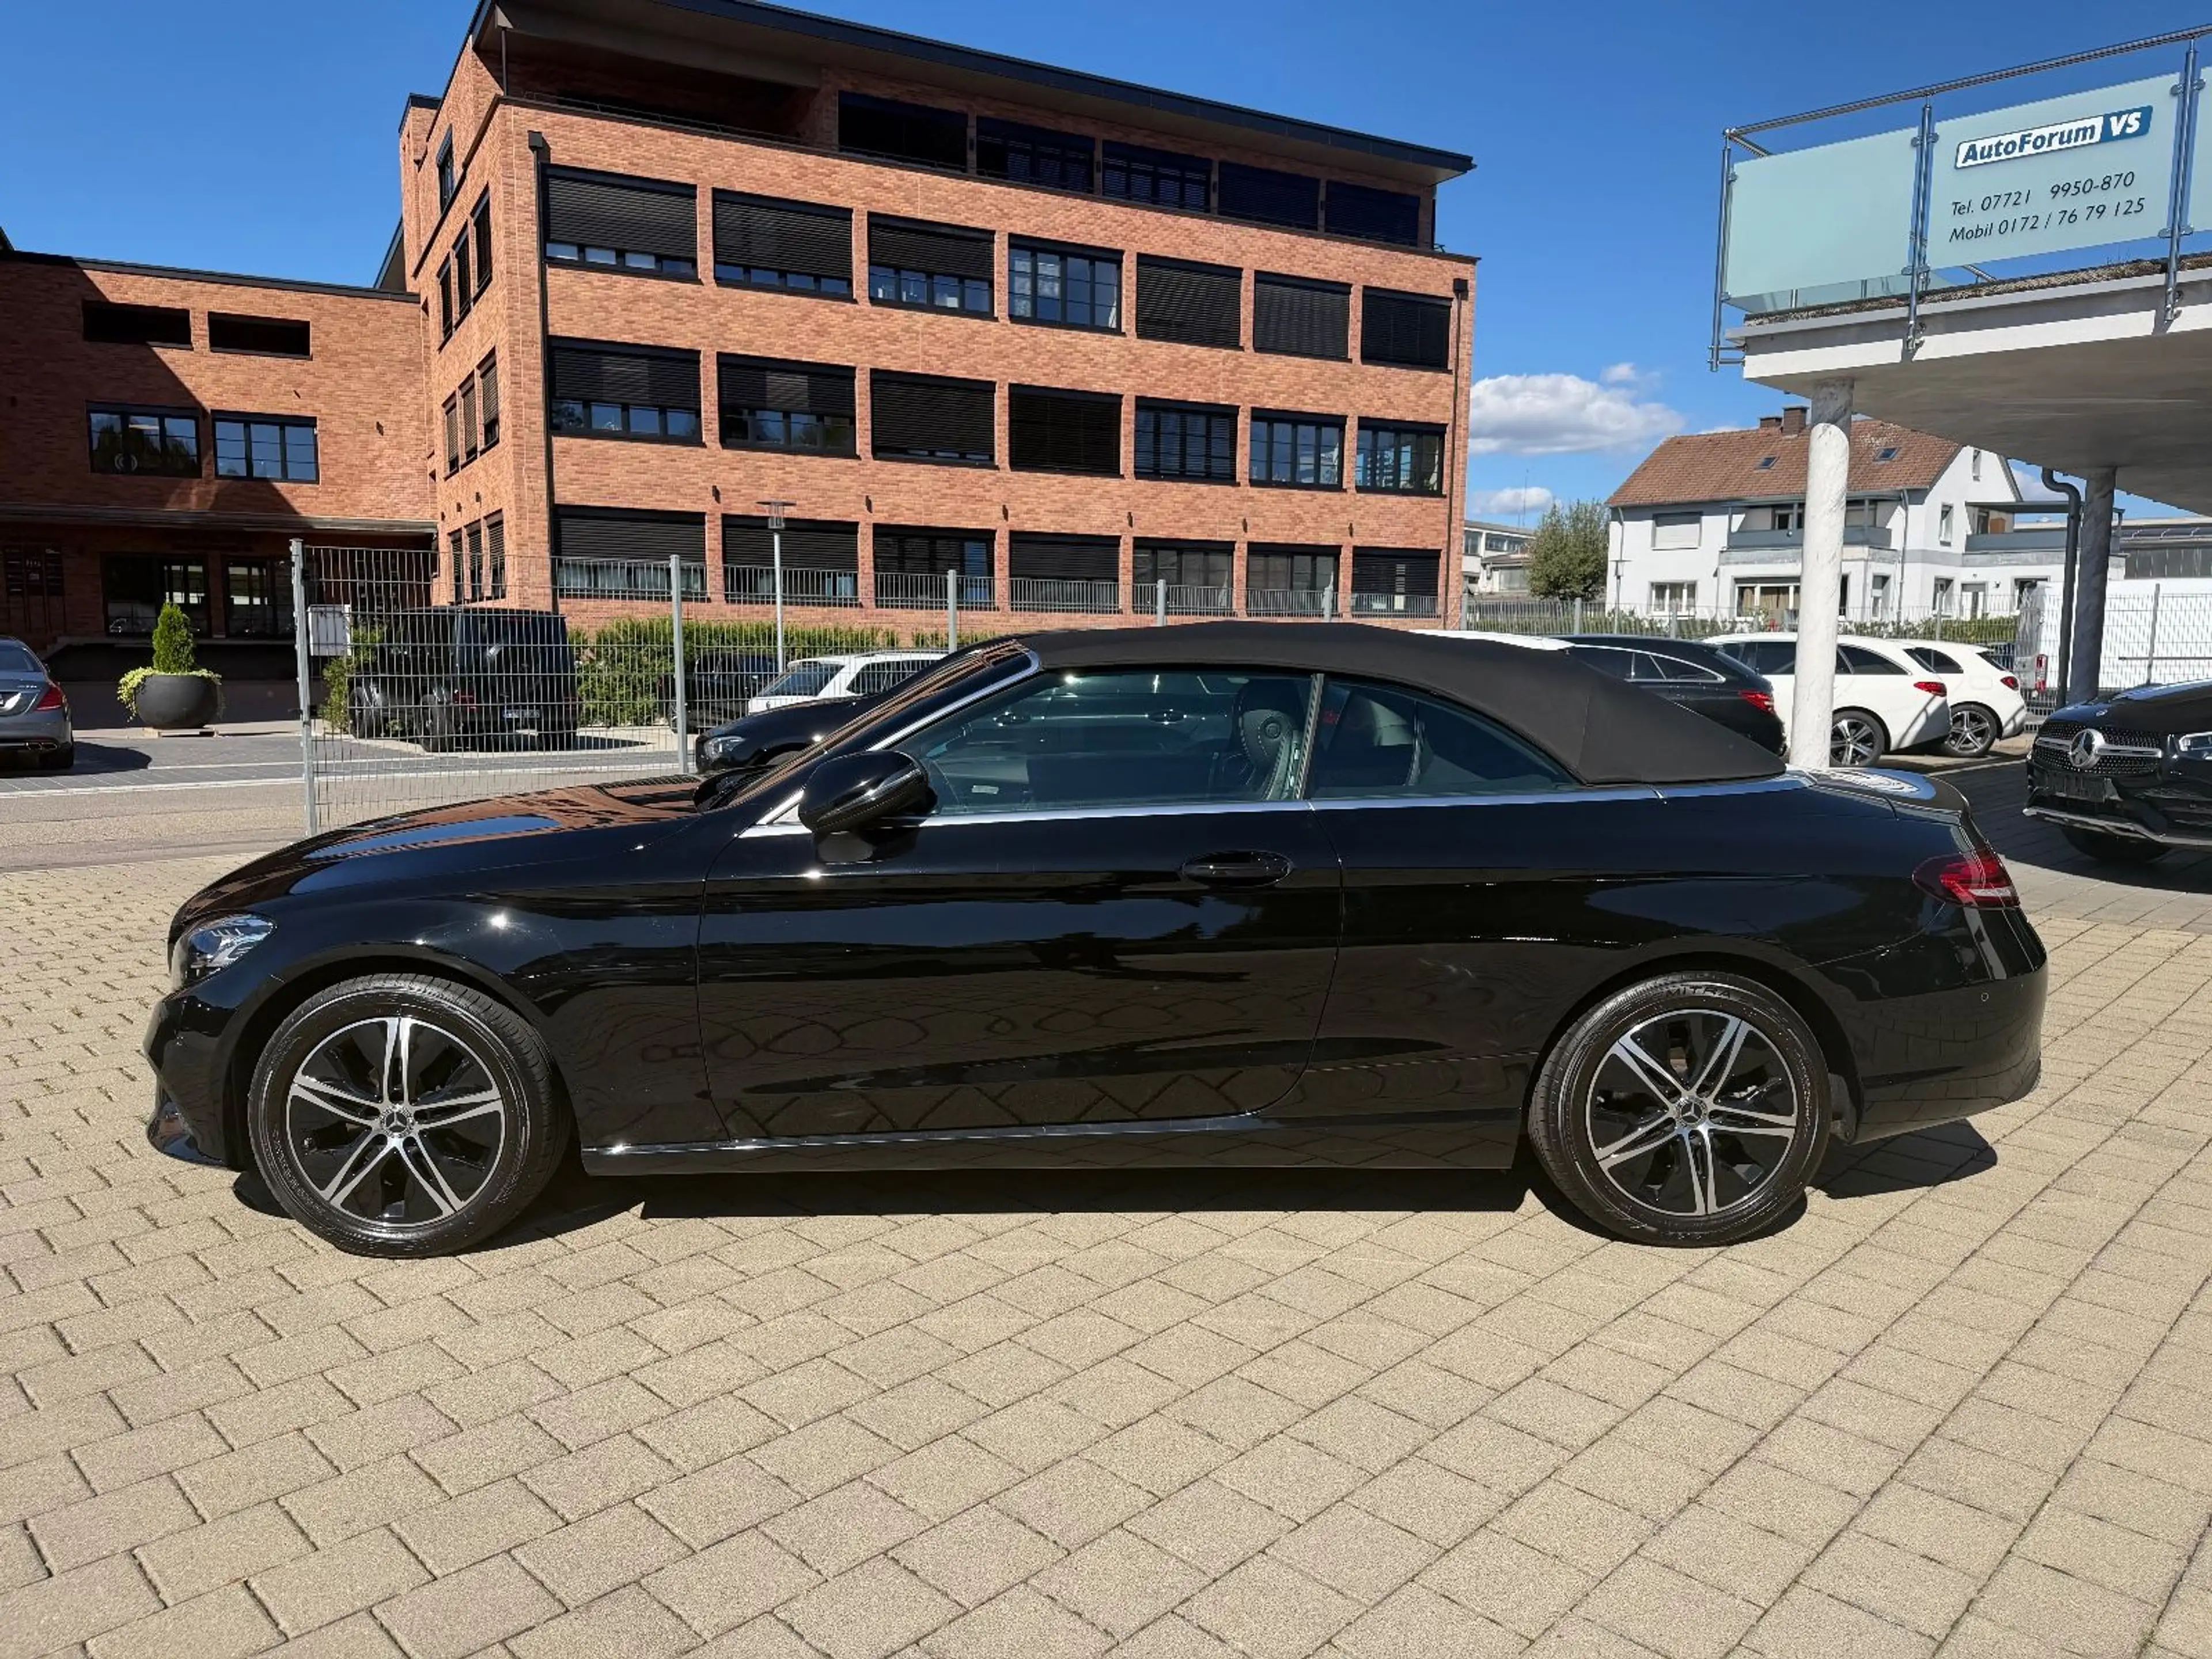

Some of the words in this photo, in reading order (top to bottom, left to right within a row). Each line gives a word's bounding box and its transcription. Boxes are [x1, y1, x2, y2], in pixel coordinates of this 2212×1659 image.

[1962, 126, 2096, 164] AutoForum
[2109, 112, 2142, 137] VS
[1952, 199, 1974, 216] Tel.
[1980, 190, 2031, 211] 07721
[2050, 171, 2135, 199] 9950-870
[1949, 222, 1993, 243] Mobil
[2058, 209, 2078, 225] 76
[2086, 204, 2106, 221] 79
[2114, 197, 2146, 217] 125
